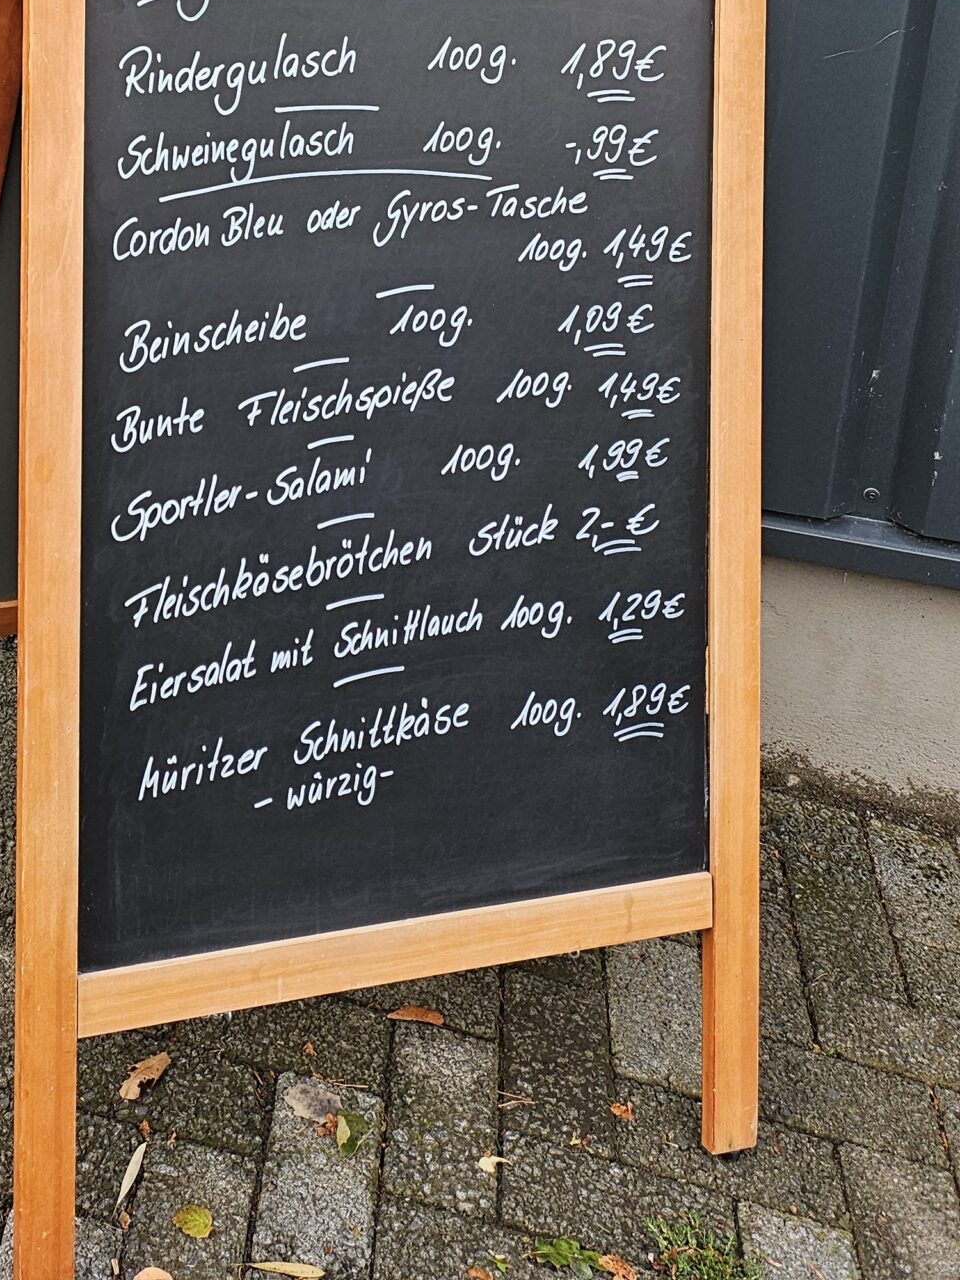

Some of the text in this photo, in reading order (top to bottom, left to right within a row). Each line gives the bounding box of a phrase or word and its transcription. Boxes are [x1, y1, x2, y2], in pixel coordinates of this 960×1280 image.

[119, 32, 356, 115] Rindergulasch
[561, 38, 667, 89] 1,89€
[117, 120, 354, 184] Schweinegulasch
[112, 183, 589, 262] Cordon Bleu oder Gyros-Tasche
[603, 225, 692, 269] 1,49€
[119, 302, 308, 373] Beinscheibe
[557, 301, 655, 346] 1,09€
[110, 403, 205, 454] Bunte
[238, 367, 456, 428] Fleischspieße
[598, 371, 681, 408] 1,49€
[578, 436, 670, 481] 1,99€
[124, 528, 433, 628] Fleischkäsebrötchen
[129, 640, 256, 712] Eiersalat
[270, 629, 313, 671] mit
[334, 597, 483, 660] Schnittlauch
[598, 591, 685, 630] 1,29€
[138, 737, 269, 801] Müritzer
[294, 697, 471, 766] Schnittkäse
[603, 683, 690, 735] 1,89€
